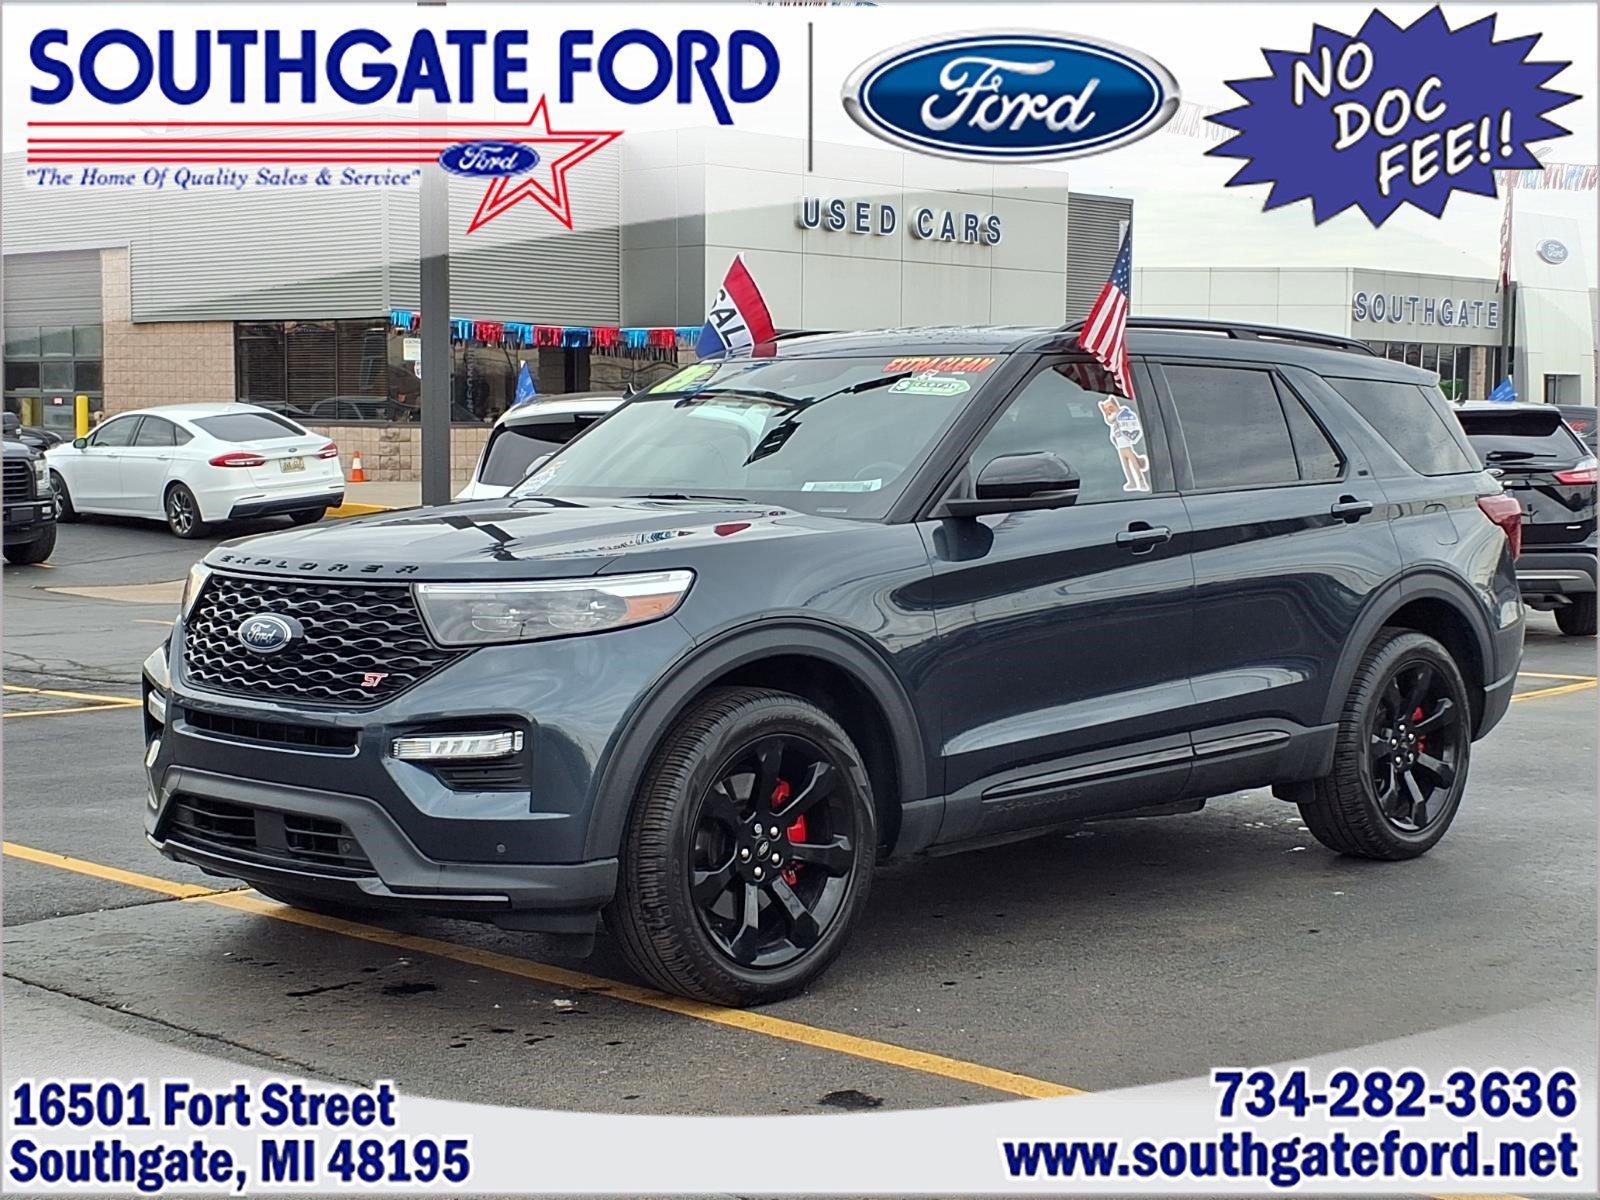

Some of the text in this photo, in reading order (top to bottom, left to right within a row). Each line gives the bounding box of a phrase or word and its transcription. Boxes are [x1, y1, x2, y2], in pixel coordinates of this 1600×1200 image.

[802, 197, 1001, 244] USED CARS
[1354, 290, 1499, 328] SOUTHGATE
[220, 554, 420, 575] EXPLORER
[246, 621, 278, 644] Ford
[360, 672, 389, 688] ST
